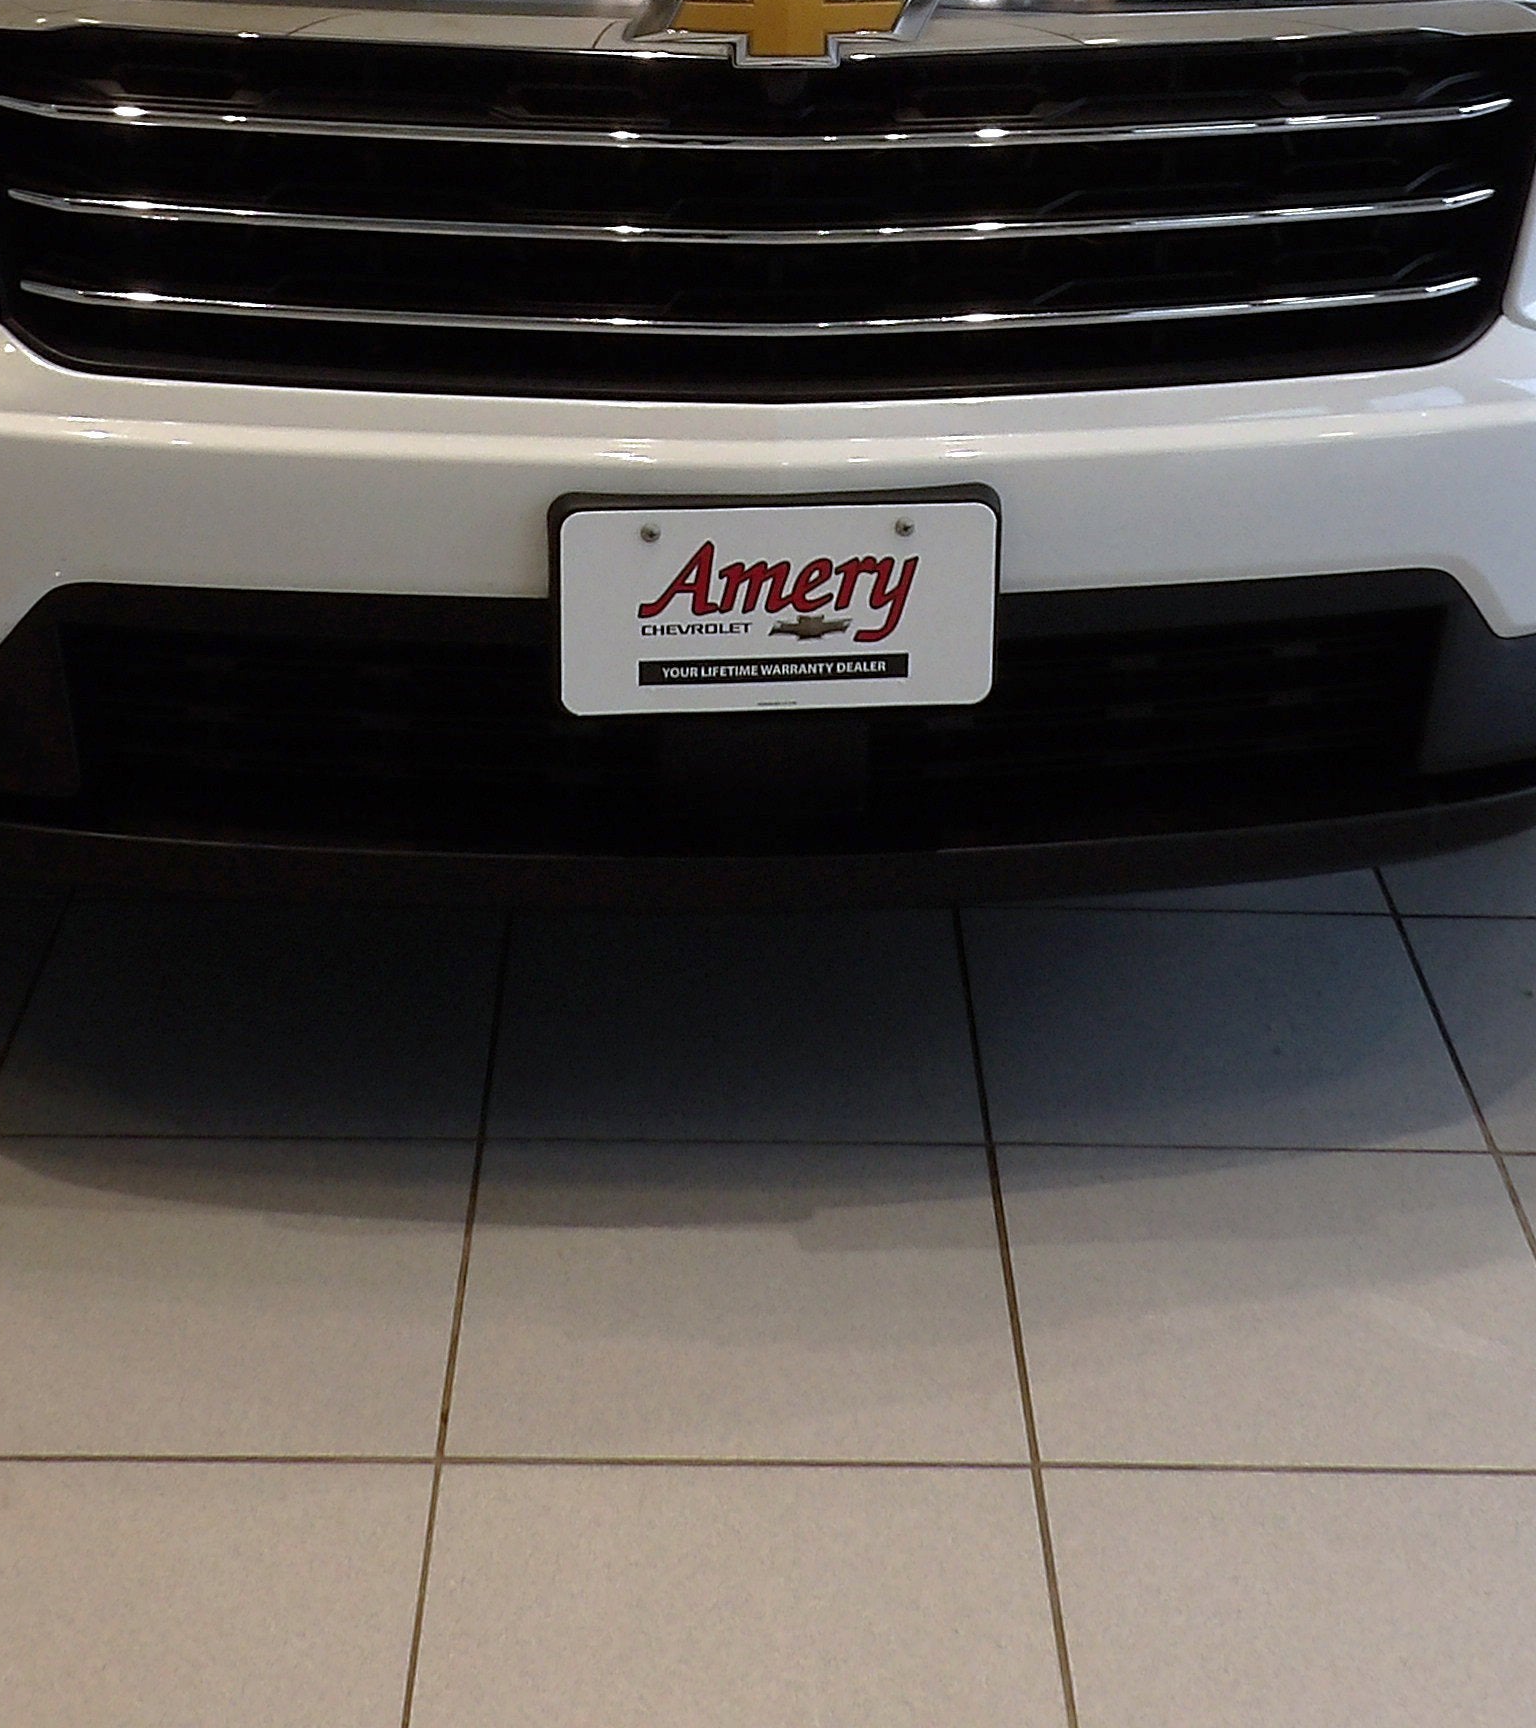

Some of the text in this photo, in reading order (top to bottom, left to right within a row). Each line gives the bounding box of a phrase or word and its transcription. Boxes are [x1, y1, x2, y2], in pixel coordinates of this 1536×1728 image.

[637, 539, 920, 643] Amery
[641, 622, 753, 636] CHEVROLET
[662, 660, 887, 679] YOUR LIFETIME WARRANTY DEALER
